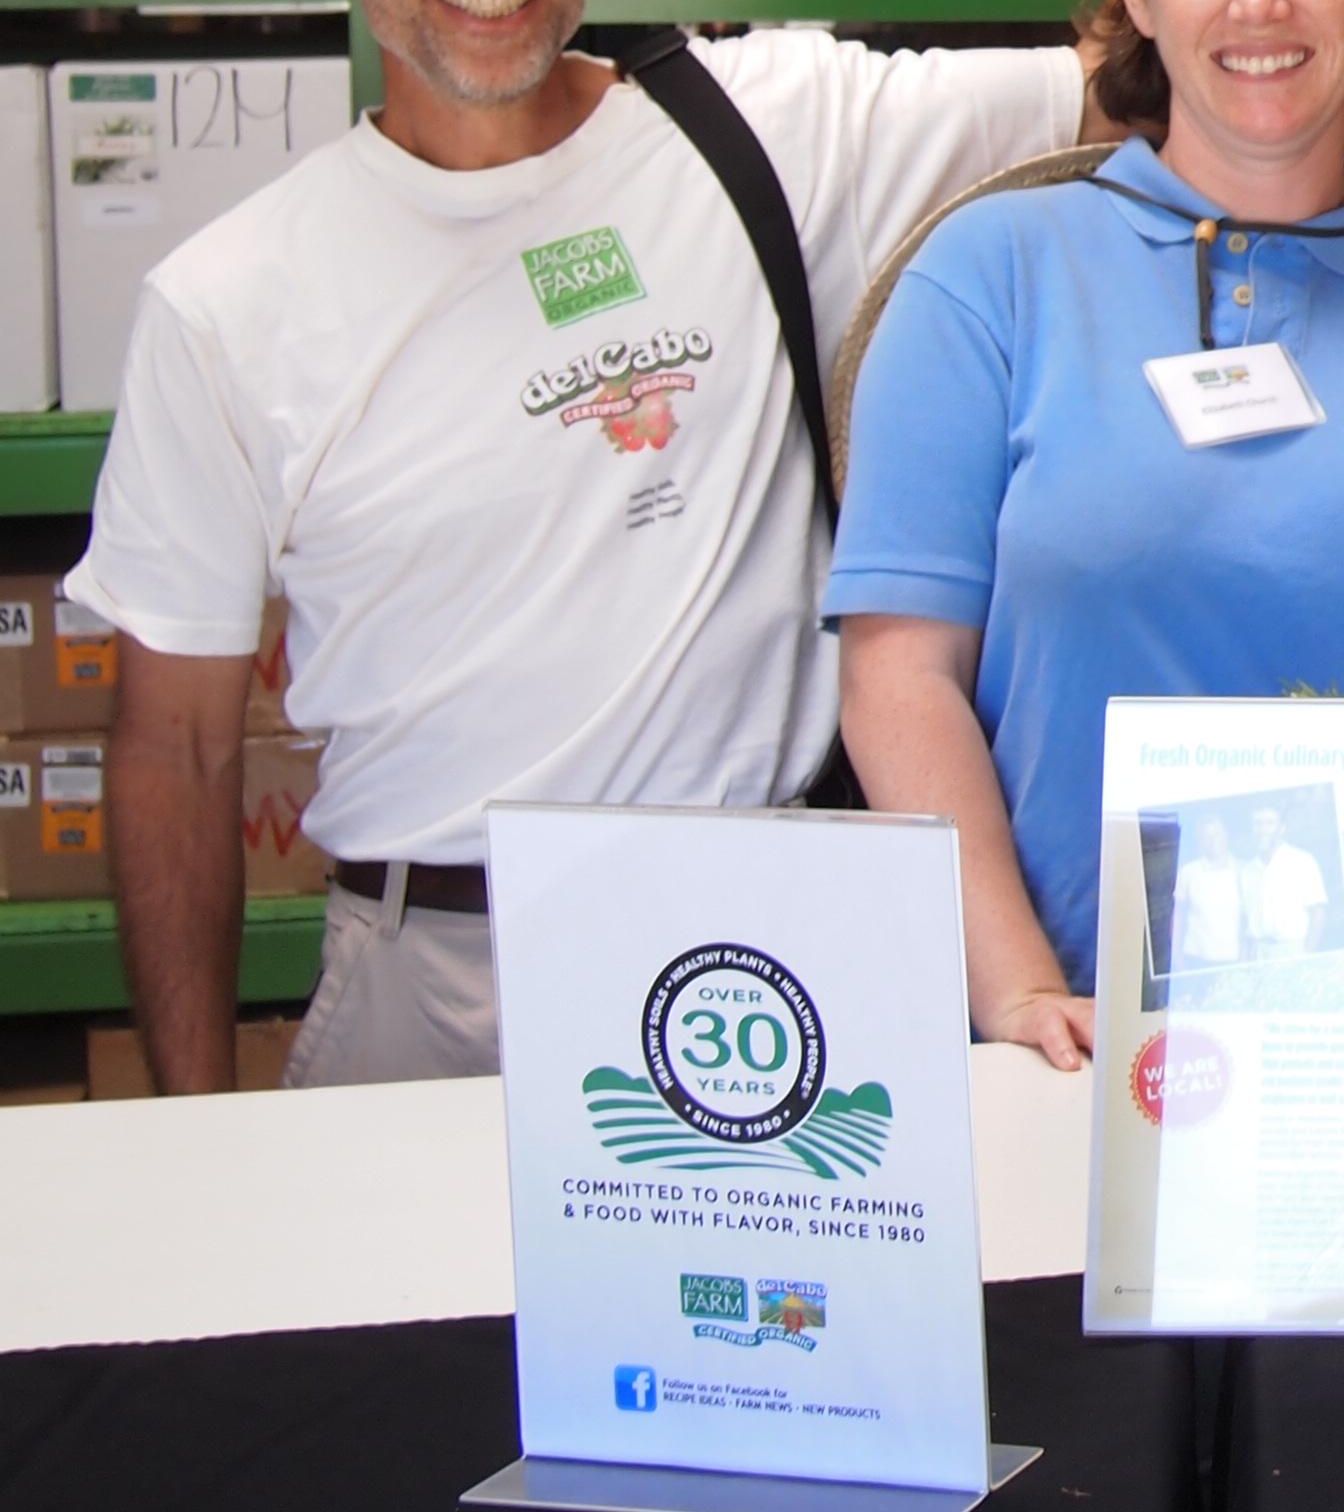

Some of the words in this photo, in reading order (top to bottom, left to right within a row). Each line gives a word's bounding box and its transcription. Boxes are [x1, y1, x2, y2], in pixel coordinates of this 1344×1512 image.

[531, 231, 613, 272] JACOBS
[534, 252, 625, 301] FARM
[548, 281, 636, 320] ORGANIC
[521, 327, 713, 414] delCabo
[1140, 744, 1189, 767] Fresh
[1196, 744, 1265, 770] Organic
[670, 950, 721, 983] HEALTHY
[724, 950, 772, 976] PLANTS
[649, 988, 668, 1026] SOILS
[698, 987, 762, 1003] OVER
[780, 979, 816, 1036] HEALTHY
[681, 1009, 788, 1072] 30
[649, 1029, 674, 1090] HEALTHY
[1144, 1064, 1175, 1082] WE
[1182, 1056, 1217, 1074] ARE
[697, 1077, 775, 1095] YEARS
[692, 1109, 740, 1136] SINCE
[746, 1115, 782, 1136] 1980
[562, 1179, 683, 1201] COMMITTED
[692, 1187, 718, 1203] TO
[727, 1189, 822, 1210] ORGANIC
[831, 1197, 924, 1218] FARMING
[564, 1204, 574, 1217] &
[584, 1204, 641, 1223] FOOD
[651, 1208, 703, 1227] WITH
[714, 1213, 800, 1237] FLAVOR,
[809, 1220, 869, 1239] SINCE
[879, 1225, 925, 1242] 1980
[685, 1277, 742, 1294] JACOBS
[683, 1292, 742, 1314] FARM
[699, 1325, 756, 1345] CERTIFIED
[759, 1328, 813, 1350] ORGANIC
[663, 1378, 694, 1392] Follow
[725, 1383, 771, 1397] Facebook
[773, 1389, 787, 1399] for
[664, 1392, 696, 1404] RECIPE
[699, 1395, 726, 1407] IDEAS
[736, 1398, 762, 1410] FARM
[766, 1401, 793, 1413] NEWS
[803, 1404, 825, 1415] NEW
[828, 1406, 881, 1420] PRODUCTS
